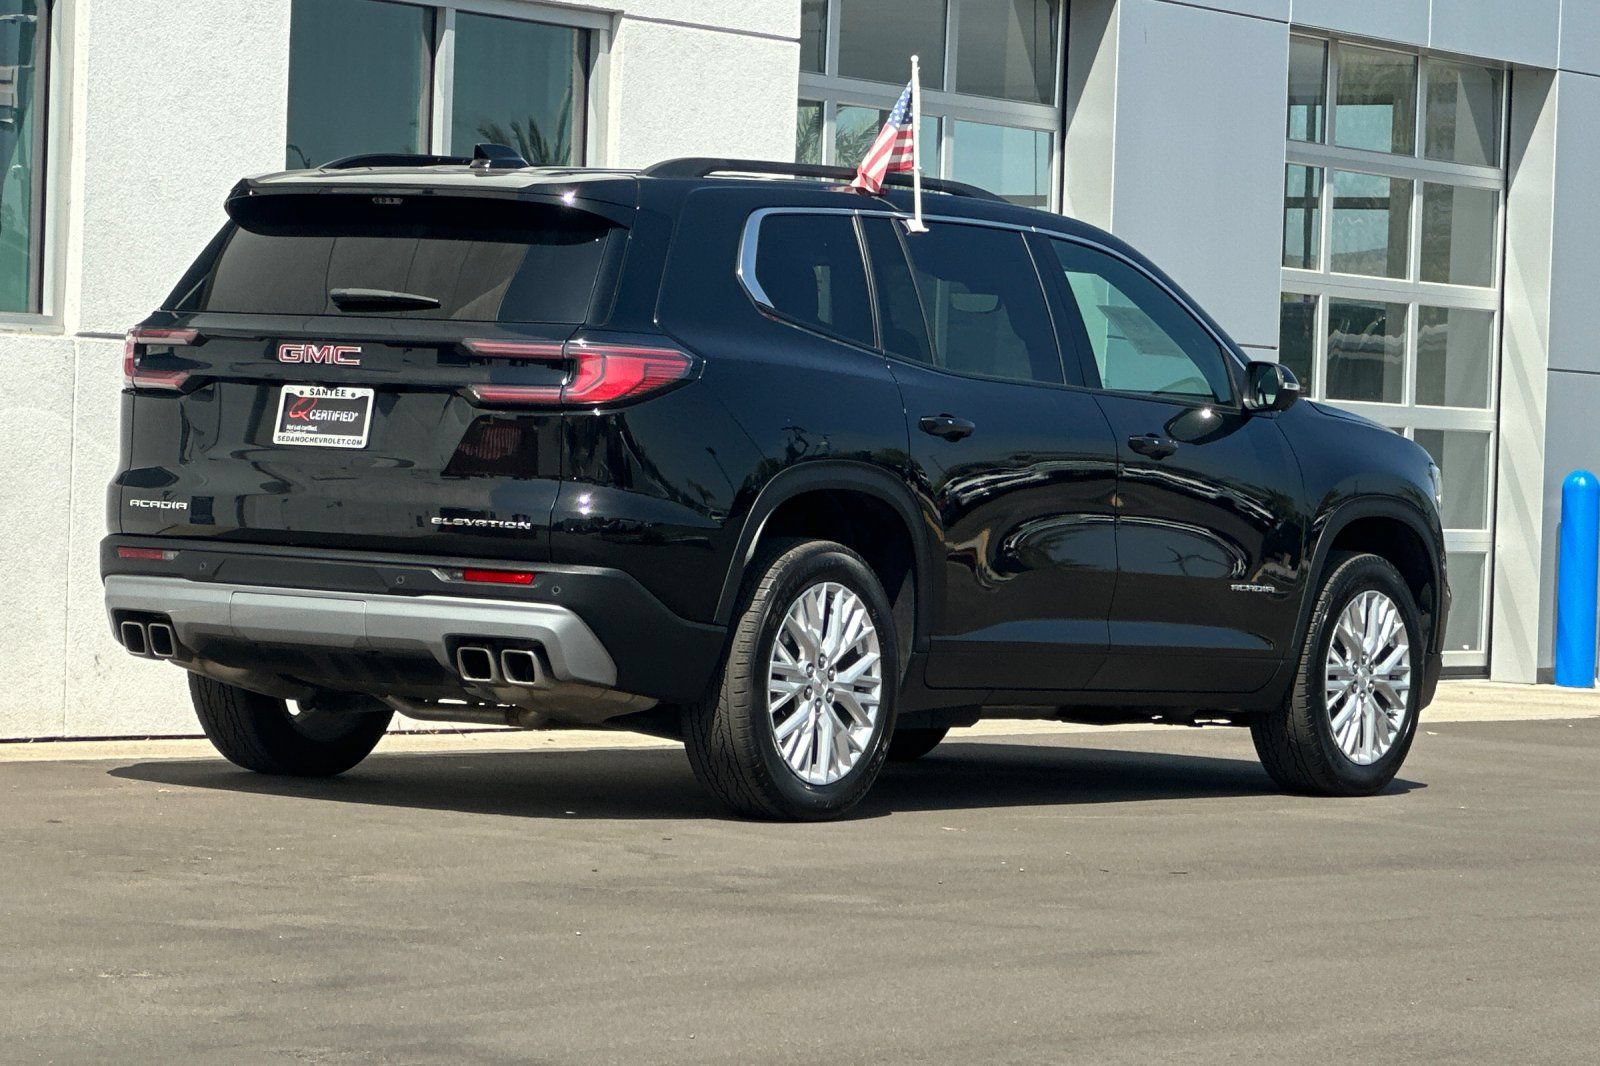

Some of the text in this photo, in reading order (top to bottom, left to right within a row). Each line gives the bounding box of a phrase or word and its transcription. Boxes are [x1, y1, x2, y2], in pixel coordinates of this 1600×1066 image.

[279, 344, 362, 366] GMC
[309, 388, 347, 397] SANTEE
[277, 435, 363, 446] SEDANOCHEVROLET.COM
[129, 499, 188, 510] ACADIA
[430, 516, 531, 530] ELEVATION
[1230, 584, 1276, 593] ACADIA
